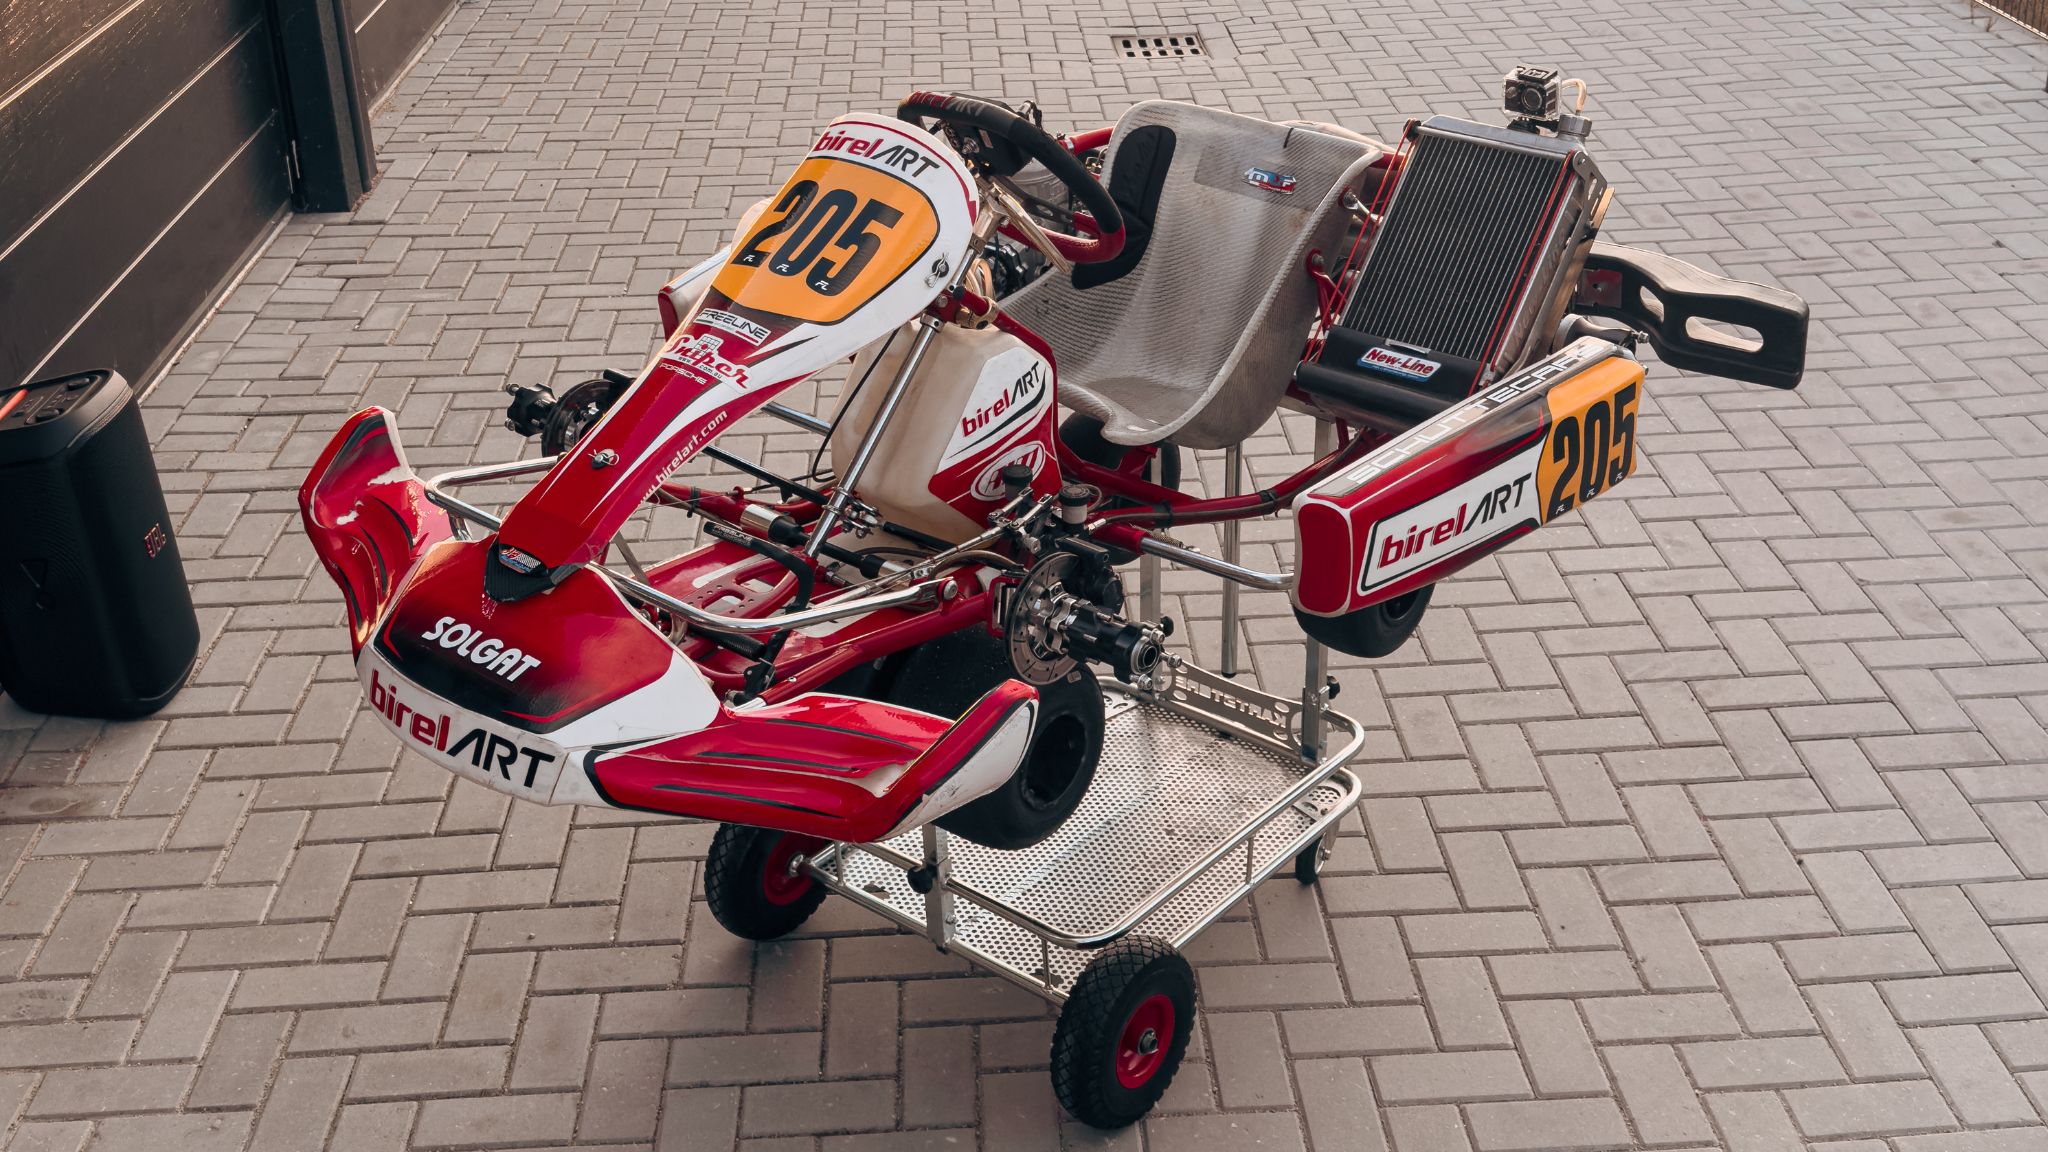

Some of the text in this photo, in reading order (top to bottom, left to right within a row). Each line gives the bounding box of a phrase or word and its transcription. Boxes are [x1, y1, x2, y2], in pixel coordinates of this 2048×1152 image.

[813, 130, 941, 178] birelART
[731, 179, 904, 296] 205
[700, 309, 768, 340] FREELINE
[660, 362, 708, 386] PORSCHE
[667, 336, 749, 389] Sniper
[1366, 348, 1434, 374] New-Line
[962, 361, 1039, 437] birelART
[640, 410, 728, 502] birelart.com
[1546, 382, 1636, 524] 205
[1377, 471, 1532, 569] birelART
[421, 616, 541, 682] SOLGAT
[370, 668, 556, 788] birelART
